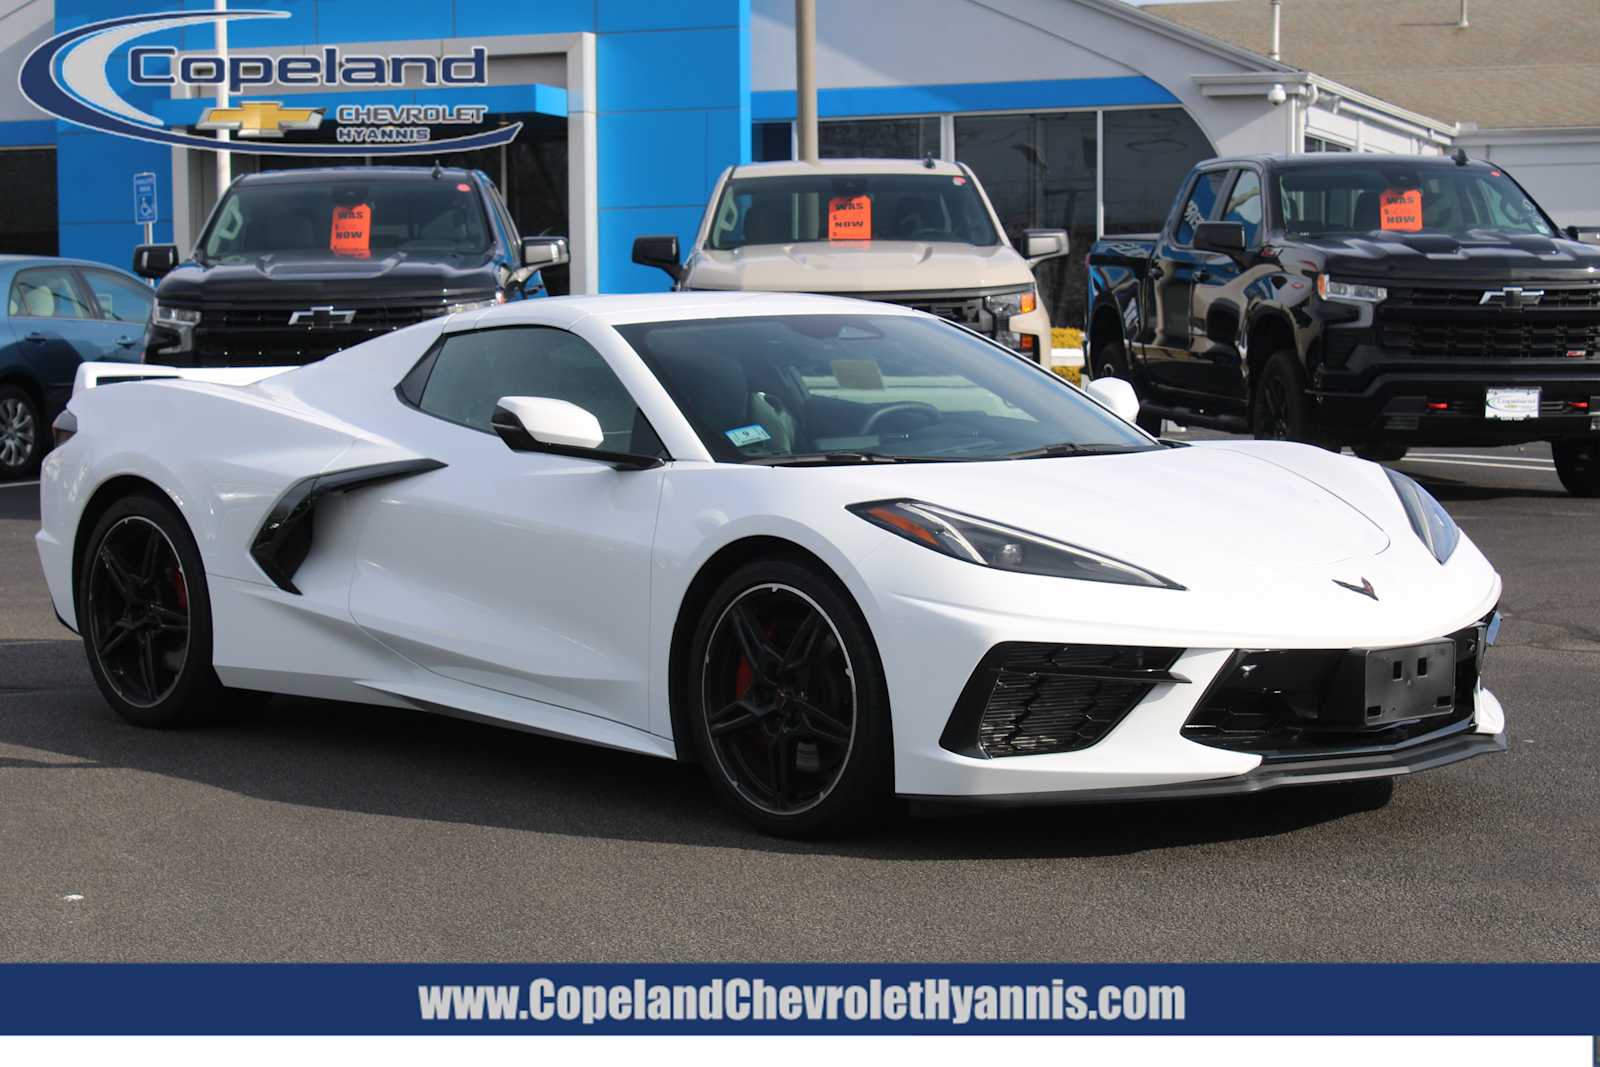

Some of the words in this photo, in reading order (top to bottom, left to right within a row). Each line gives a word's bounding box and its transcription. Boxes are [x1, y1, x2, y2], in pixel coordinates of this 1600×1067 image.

[1386, 196, 1415, 205] WAS
[835, 202, 864, 211] WAS
[336, 211, 364, 220] WAS
[1386, 215, 1415, 224] NOW
[335, 231, 363, 240] NOW
